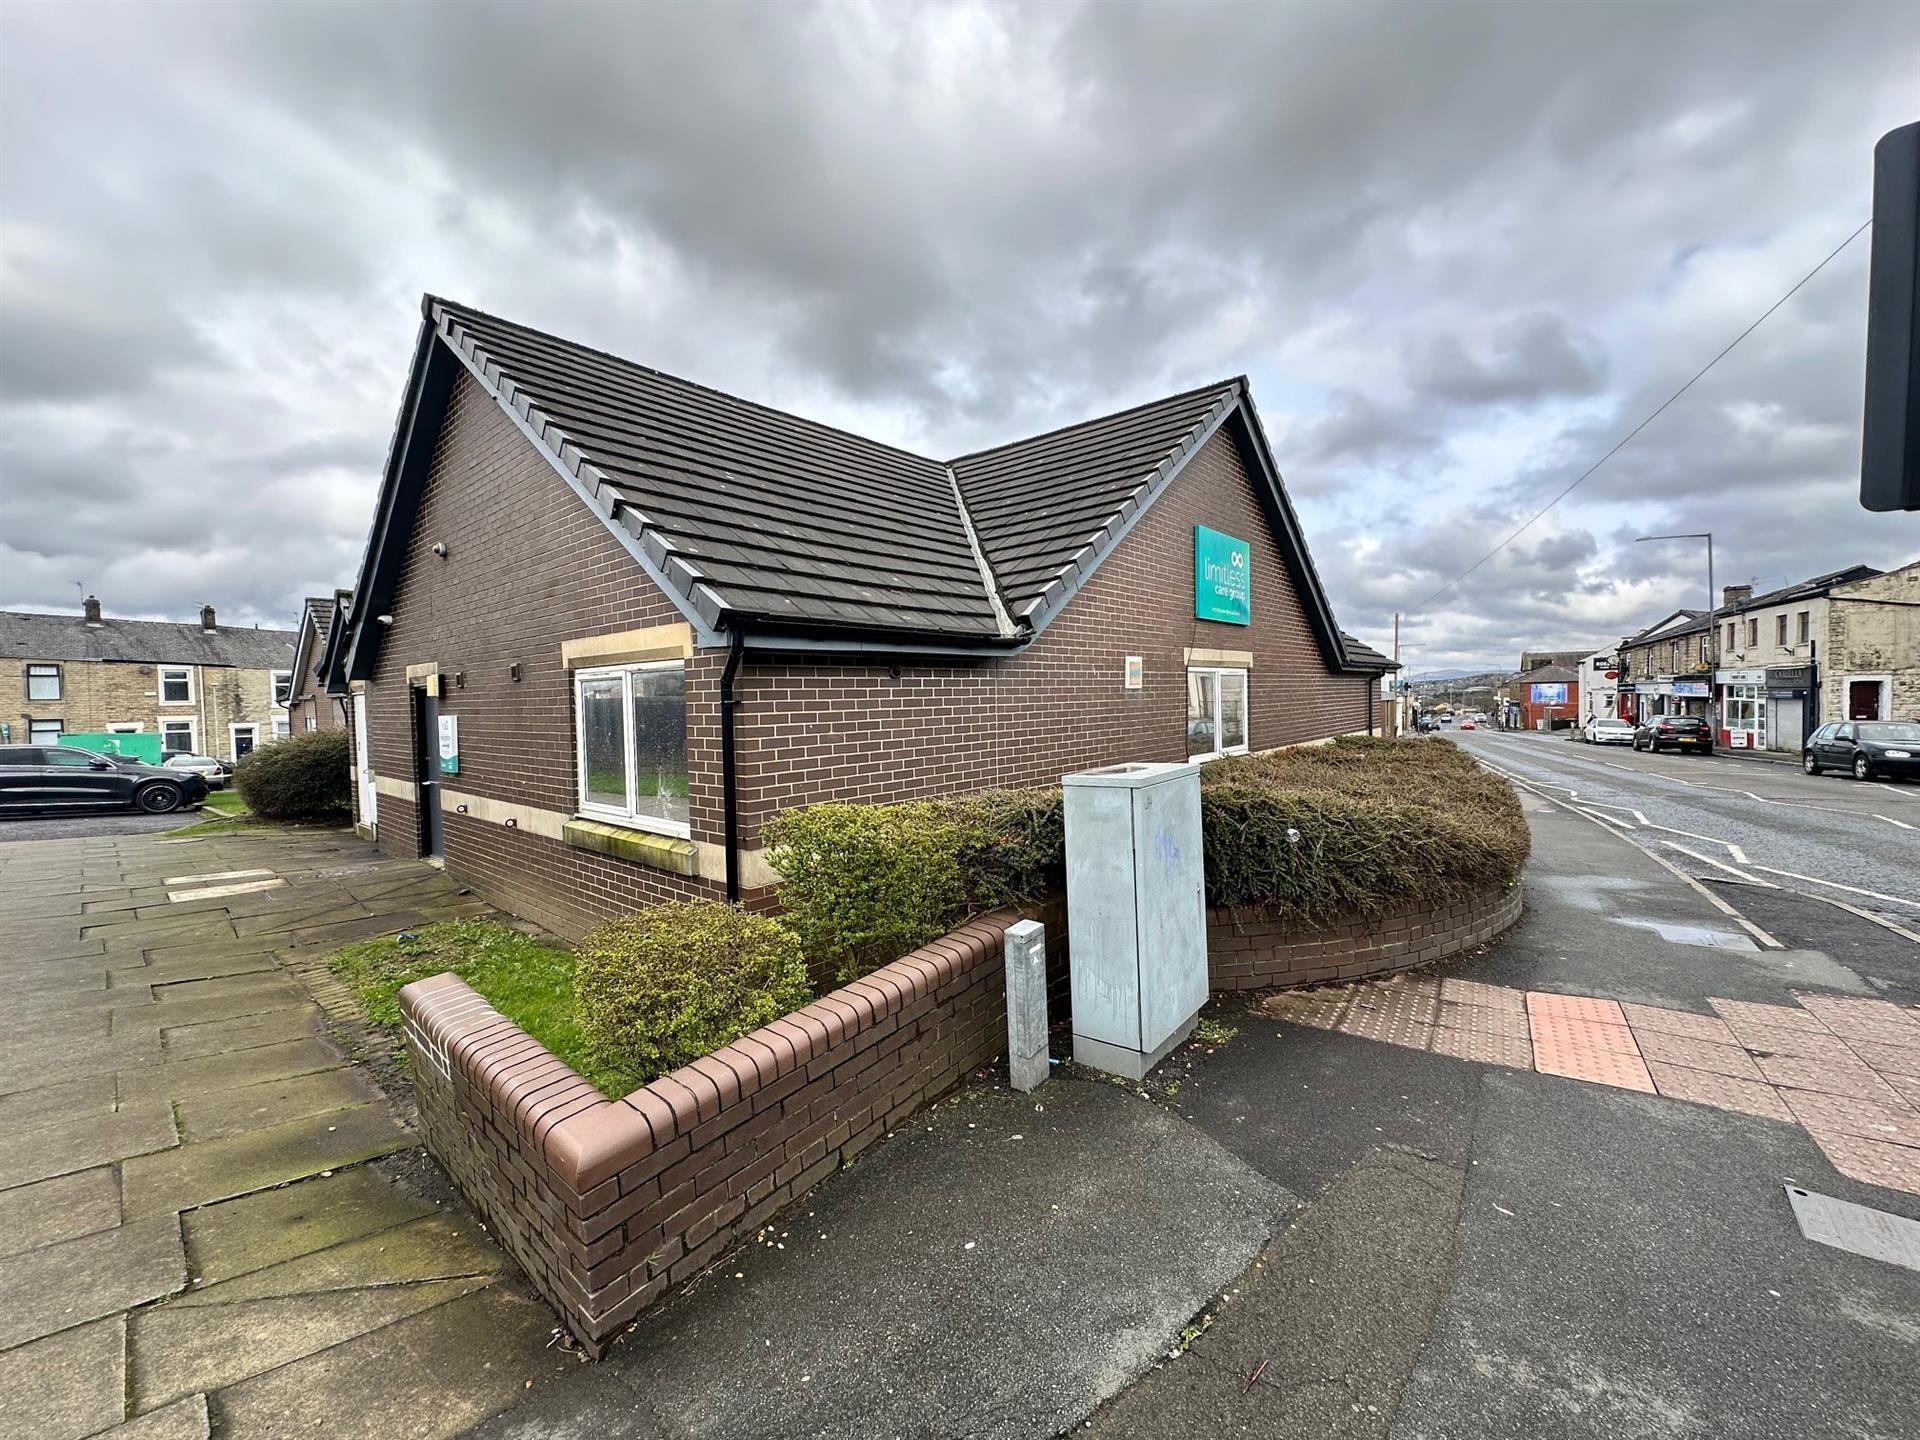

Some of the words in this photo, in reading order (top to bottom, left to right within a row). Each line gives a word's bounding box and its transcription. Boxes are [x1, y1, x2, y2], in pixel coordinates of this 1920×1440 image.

[1204, 556, 1245, 589] limitless
[1214, 585, 1228, 596] care
[1228, 588, 1245, 602] group
